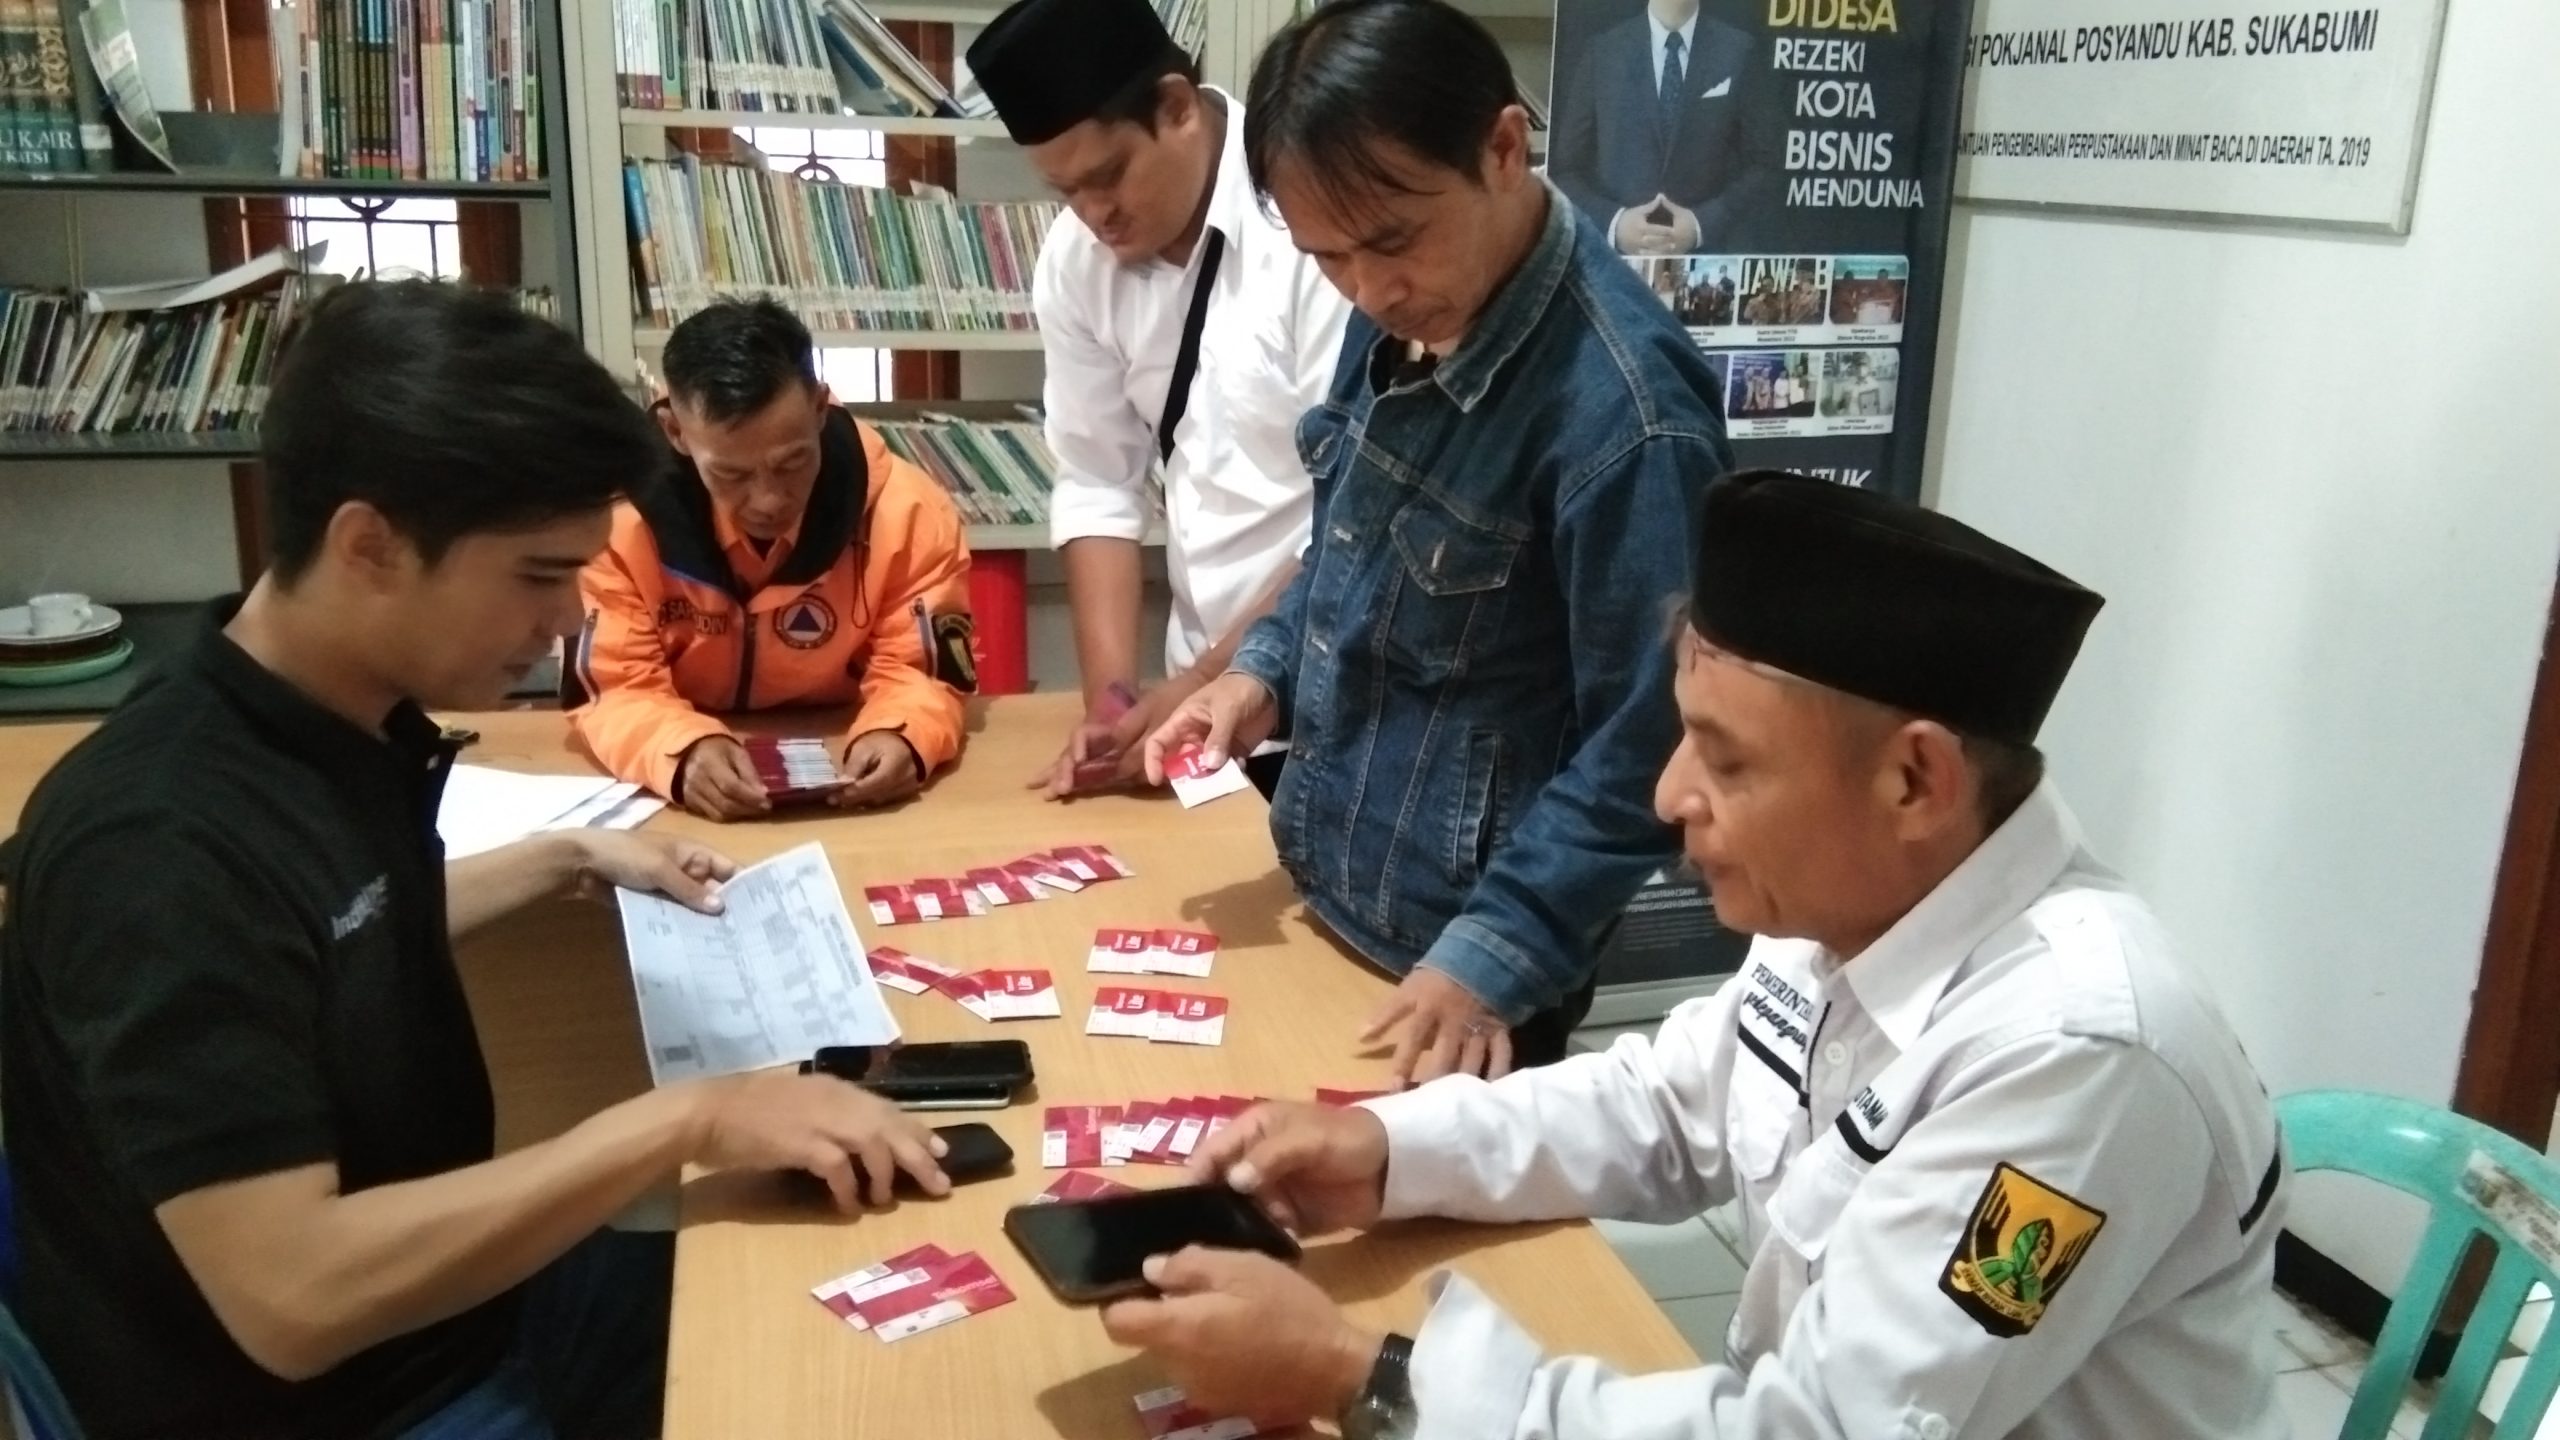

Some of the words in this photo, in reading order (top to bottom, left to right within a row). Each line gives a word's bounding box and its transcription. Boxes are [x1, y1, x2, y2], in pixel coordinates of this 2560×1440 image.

[1768, 0, 1808, 28] DI
[1811, 0, 1898, 33] DESA
[1772, 37, 1867, 73] REZEKI
[1979, 29, 2069, 68] POKJANAL
[2073, 21, 2184, 63] POSYANDU
[2185, 18, 2238, 58] KAB.
[2245, 8, 2380, 56] SUKABUMI
[1795, 80, 1877, 119] KOTA
[1784, 130, 1894, 172] BISNIS
[1990, 132, 2068, 159] PENGEMBANGAN
[2067, 133, 2150, 161] PERPUSTAKAAN
[2148, 133, 2175, 161] DAN
[2173, 134, 2211, 163] MINAT
[2209, 134, 2244, 163] BACA
[2245, 135, 2260, 164] DI
[2259, 135, 2315, 166] DAERAH
[2316, 136, 2335, 166] TA.
[2338, 136, 2372, 167] 2019
[1786, 177, 1926, 209] MENDUNIA
